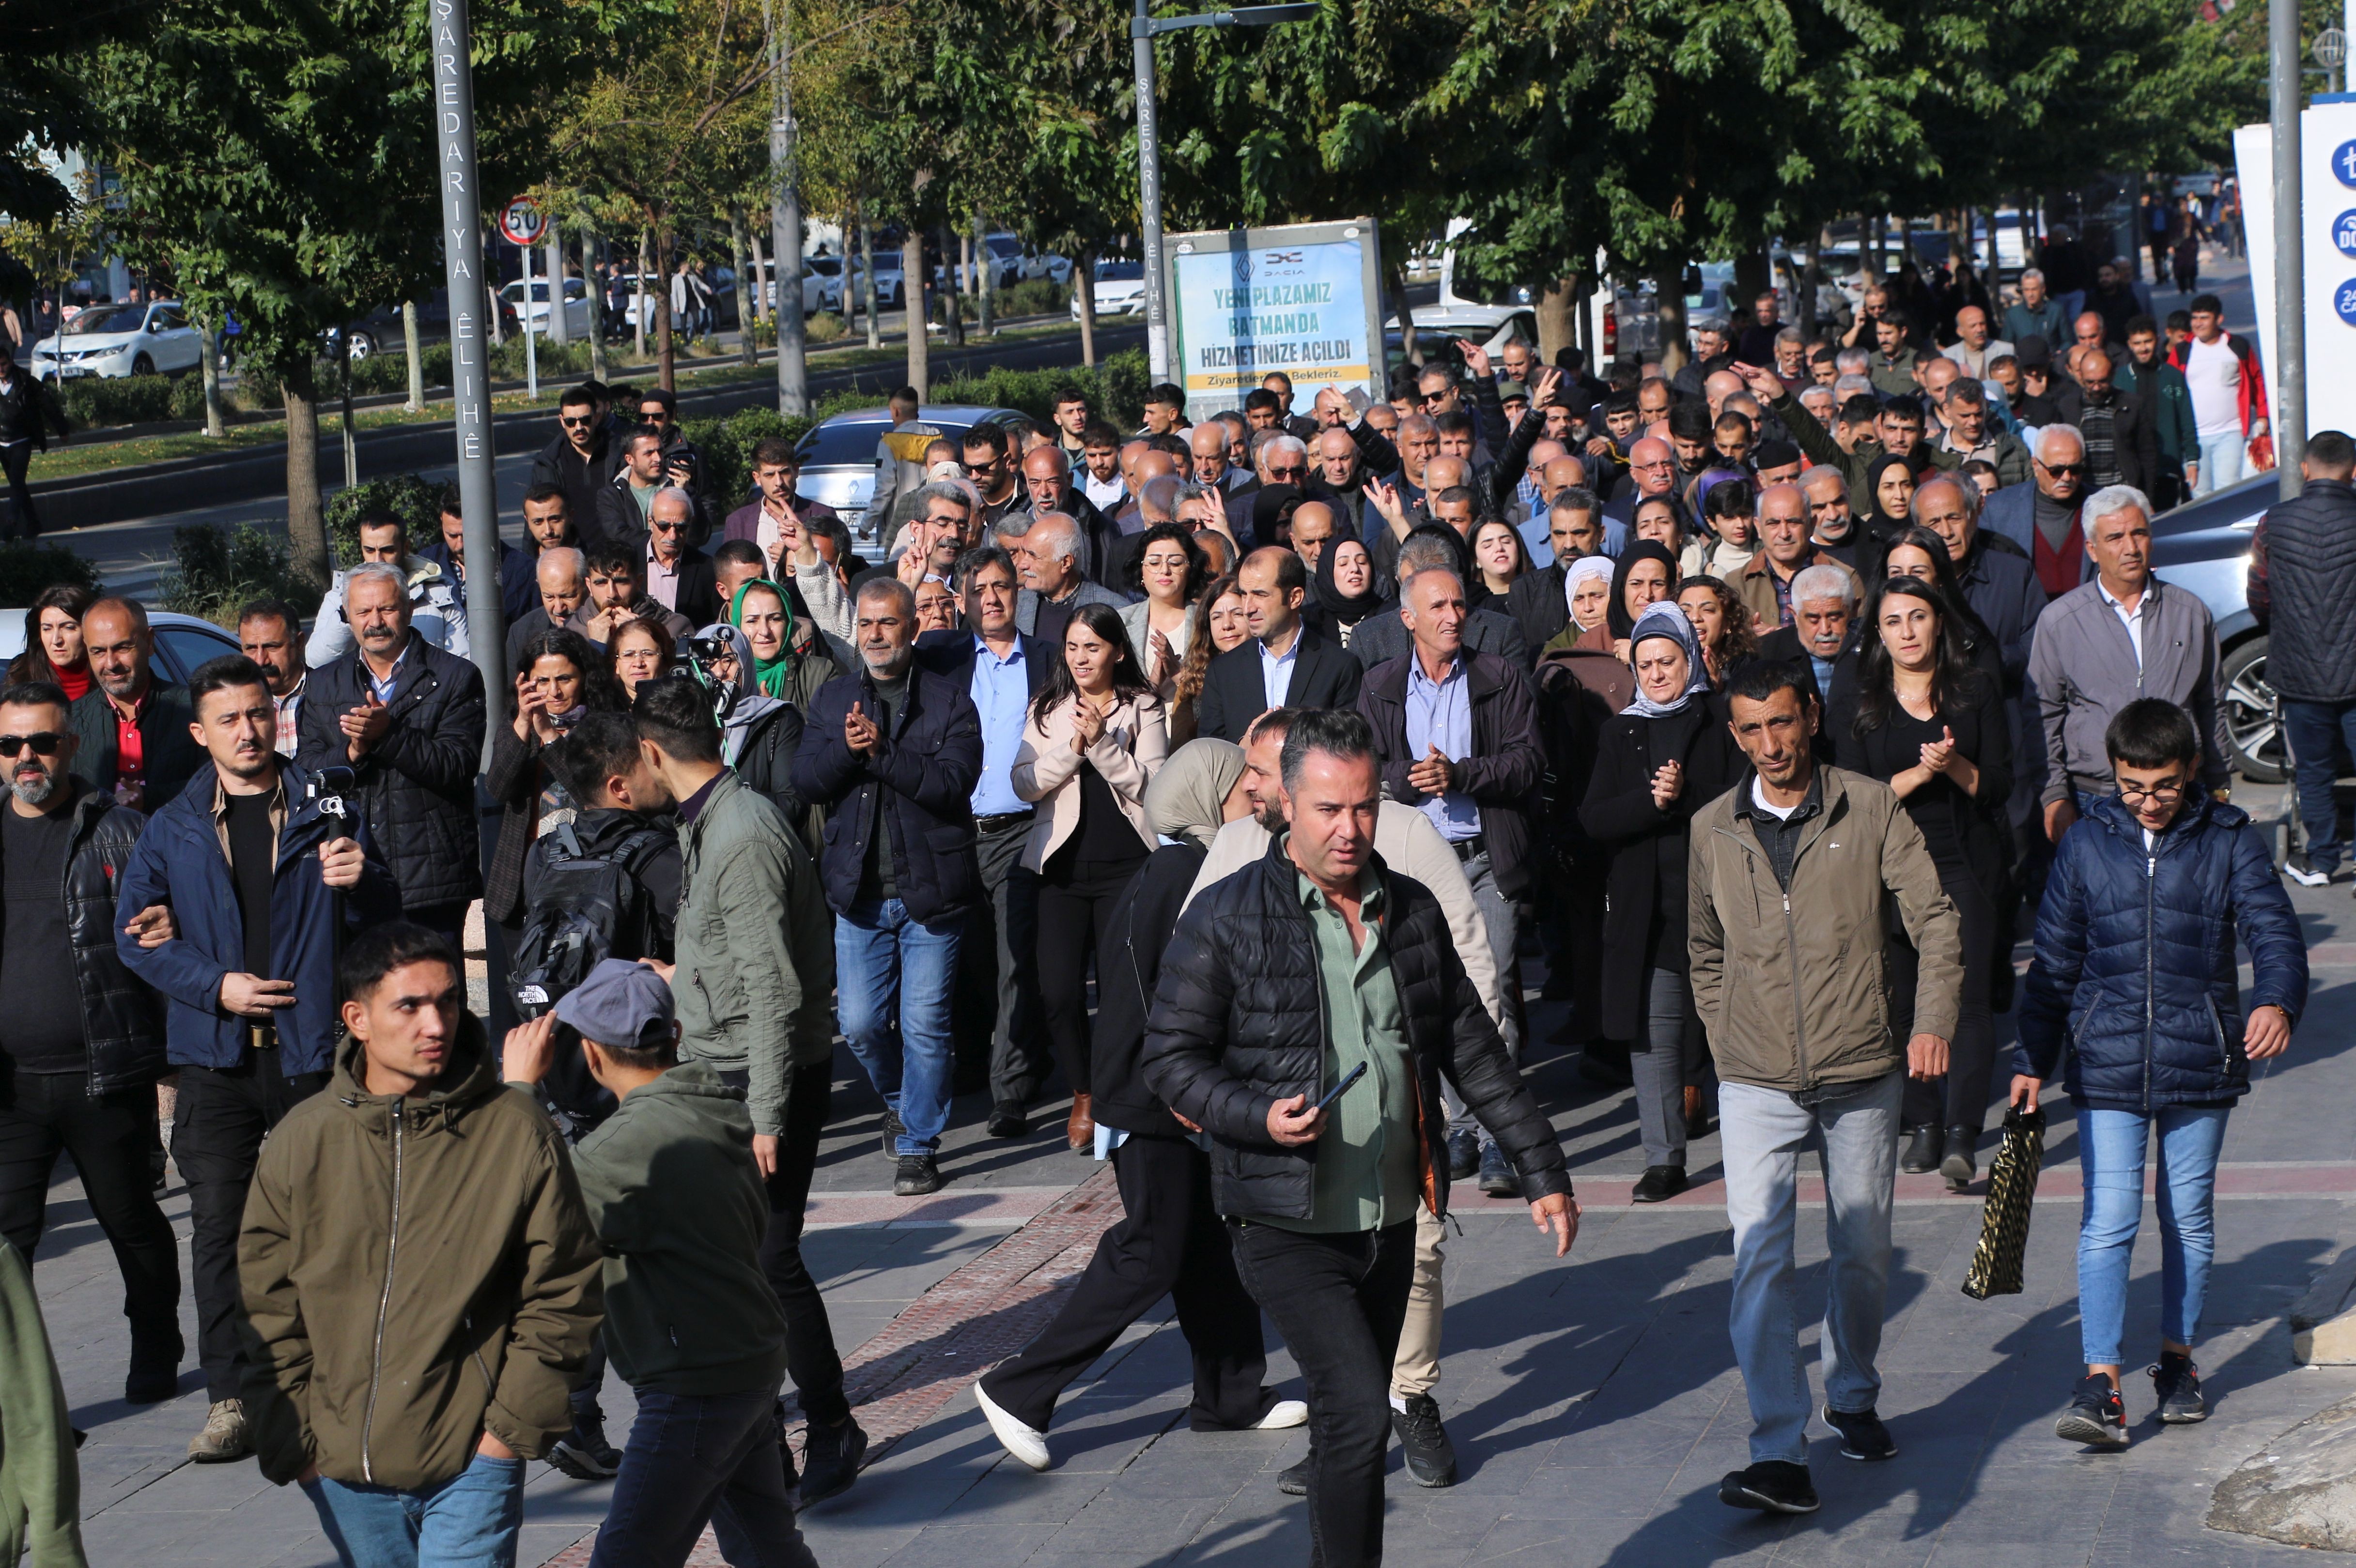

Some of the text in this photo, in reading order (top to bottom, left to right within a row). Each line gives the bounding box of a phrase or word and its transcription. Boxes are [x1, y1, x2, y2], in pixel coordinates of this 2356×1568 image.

[1139, 78, 1156, 226] ŞAREDARIYA
[1148, 243, 1160, 320] ÊLIHÊ
[437, 0, 480, 460] ŞAREDARIYA ÊLIHÊ
[510, 209, 537, 230] 50
[1213, 282, 1332, 309] YENİ PLAZAMIZ
[1228, 312, 1319, 338] BATMAN'DA
[1201, 339, 1351, 368] HİZMETİNİZE AÇILDI
[1292, 369, 1342, 381] Bekleriz.
